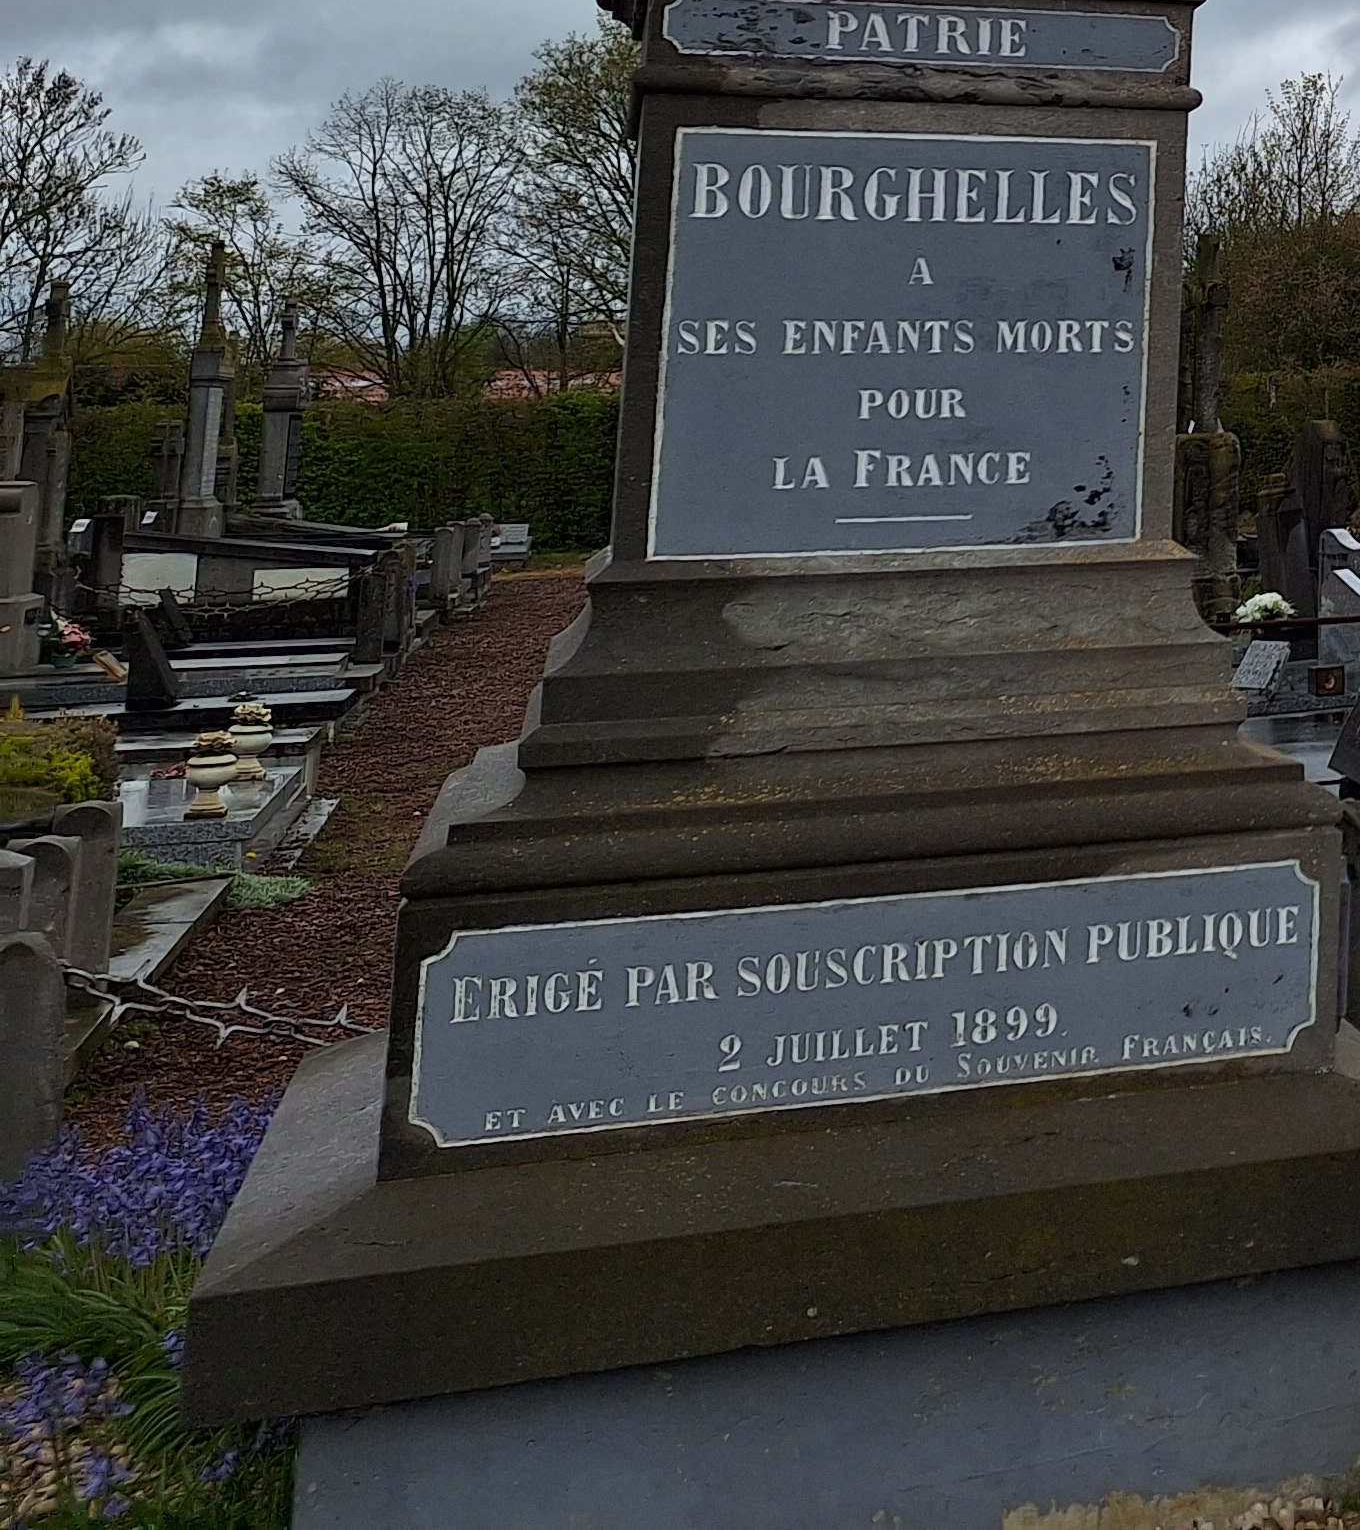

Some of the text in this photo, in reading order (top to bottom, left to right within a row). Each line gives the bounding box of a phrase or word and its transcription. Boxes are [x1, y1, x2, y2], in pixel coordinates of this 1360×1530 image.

[824, 9, 1028, 58] PATRIE
[689, 162, 1137, 226] BOURGHELLES
[908, 257, 934, 286] A
[677, 319, 1135, 356] SES ENFANTS MORTS
[857, 388, 966, 420] POUR
[772, 449, 1031, 490] LA FRANCE
[625, 960, 720, 1008] PAR
[737, 927, 1070, 998] SOUSCRIPTION
[1085, 905, 1300, 964] PUBLIQUE
[718, 1033, 742, 1072] 2
[766, 1021, 929, 1067] JUILLET
[484, 1108, 526, 1131] ET
[547, 1097, 625, 1124] AVEC
[646, 1091, 684, 1113] LE
[711, 1070, 867, 1104] CONCOURS
[895, 1065, 930, 1086] DU
